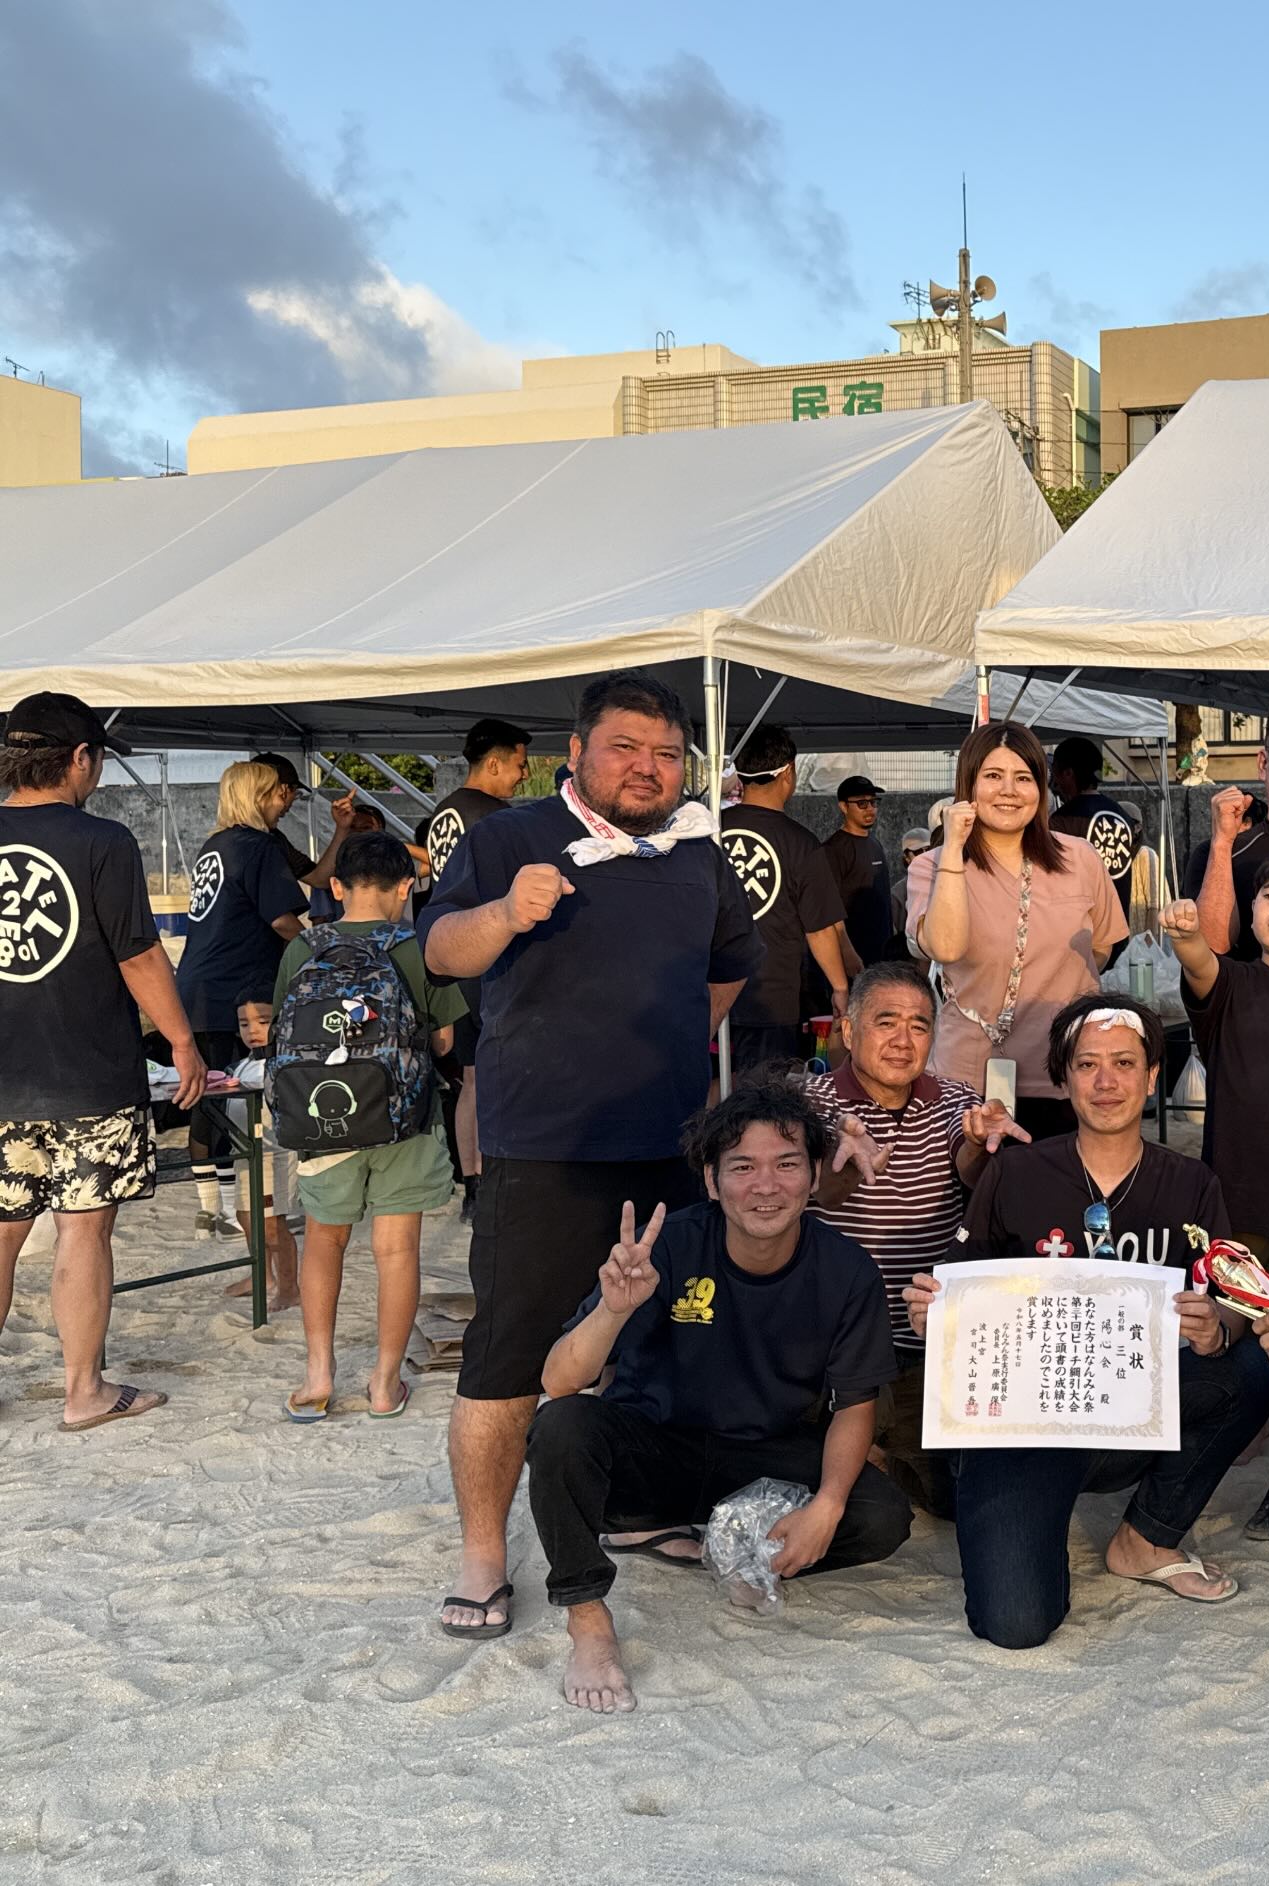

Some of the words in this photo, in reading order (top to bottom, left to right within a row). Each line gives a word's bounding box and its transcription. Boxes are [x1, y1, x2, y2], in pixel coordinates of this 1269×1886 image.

[792, 380, 885, 422] 民宿
[676, 1276, 716, 1308] 39
[1026, 1296, 1038, 1341] 賞します
[1039, 1296, 1053, 1413] 収めましたのでこれを
[1053, 1296, 1068, 1413] に於いて頭書の成績を
[1083, 1296, 1096, 1413] あなた方はなんみん祭
[1115, 1345, 1127, 1380] 三位
[1128, 1323, 1145, 1370] 賞状
